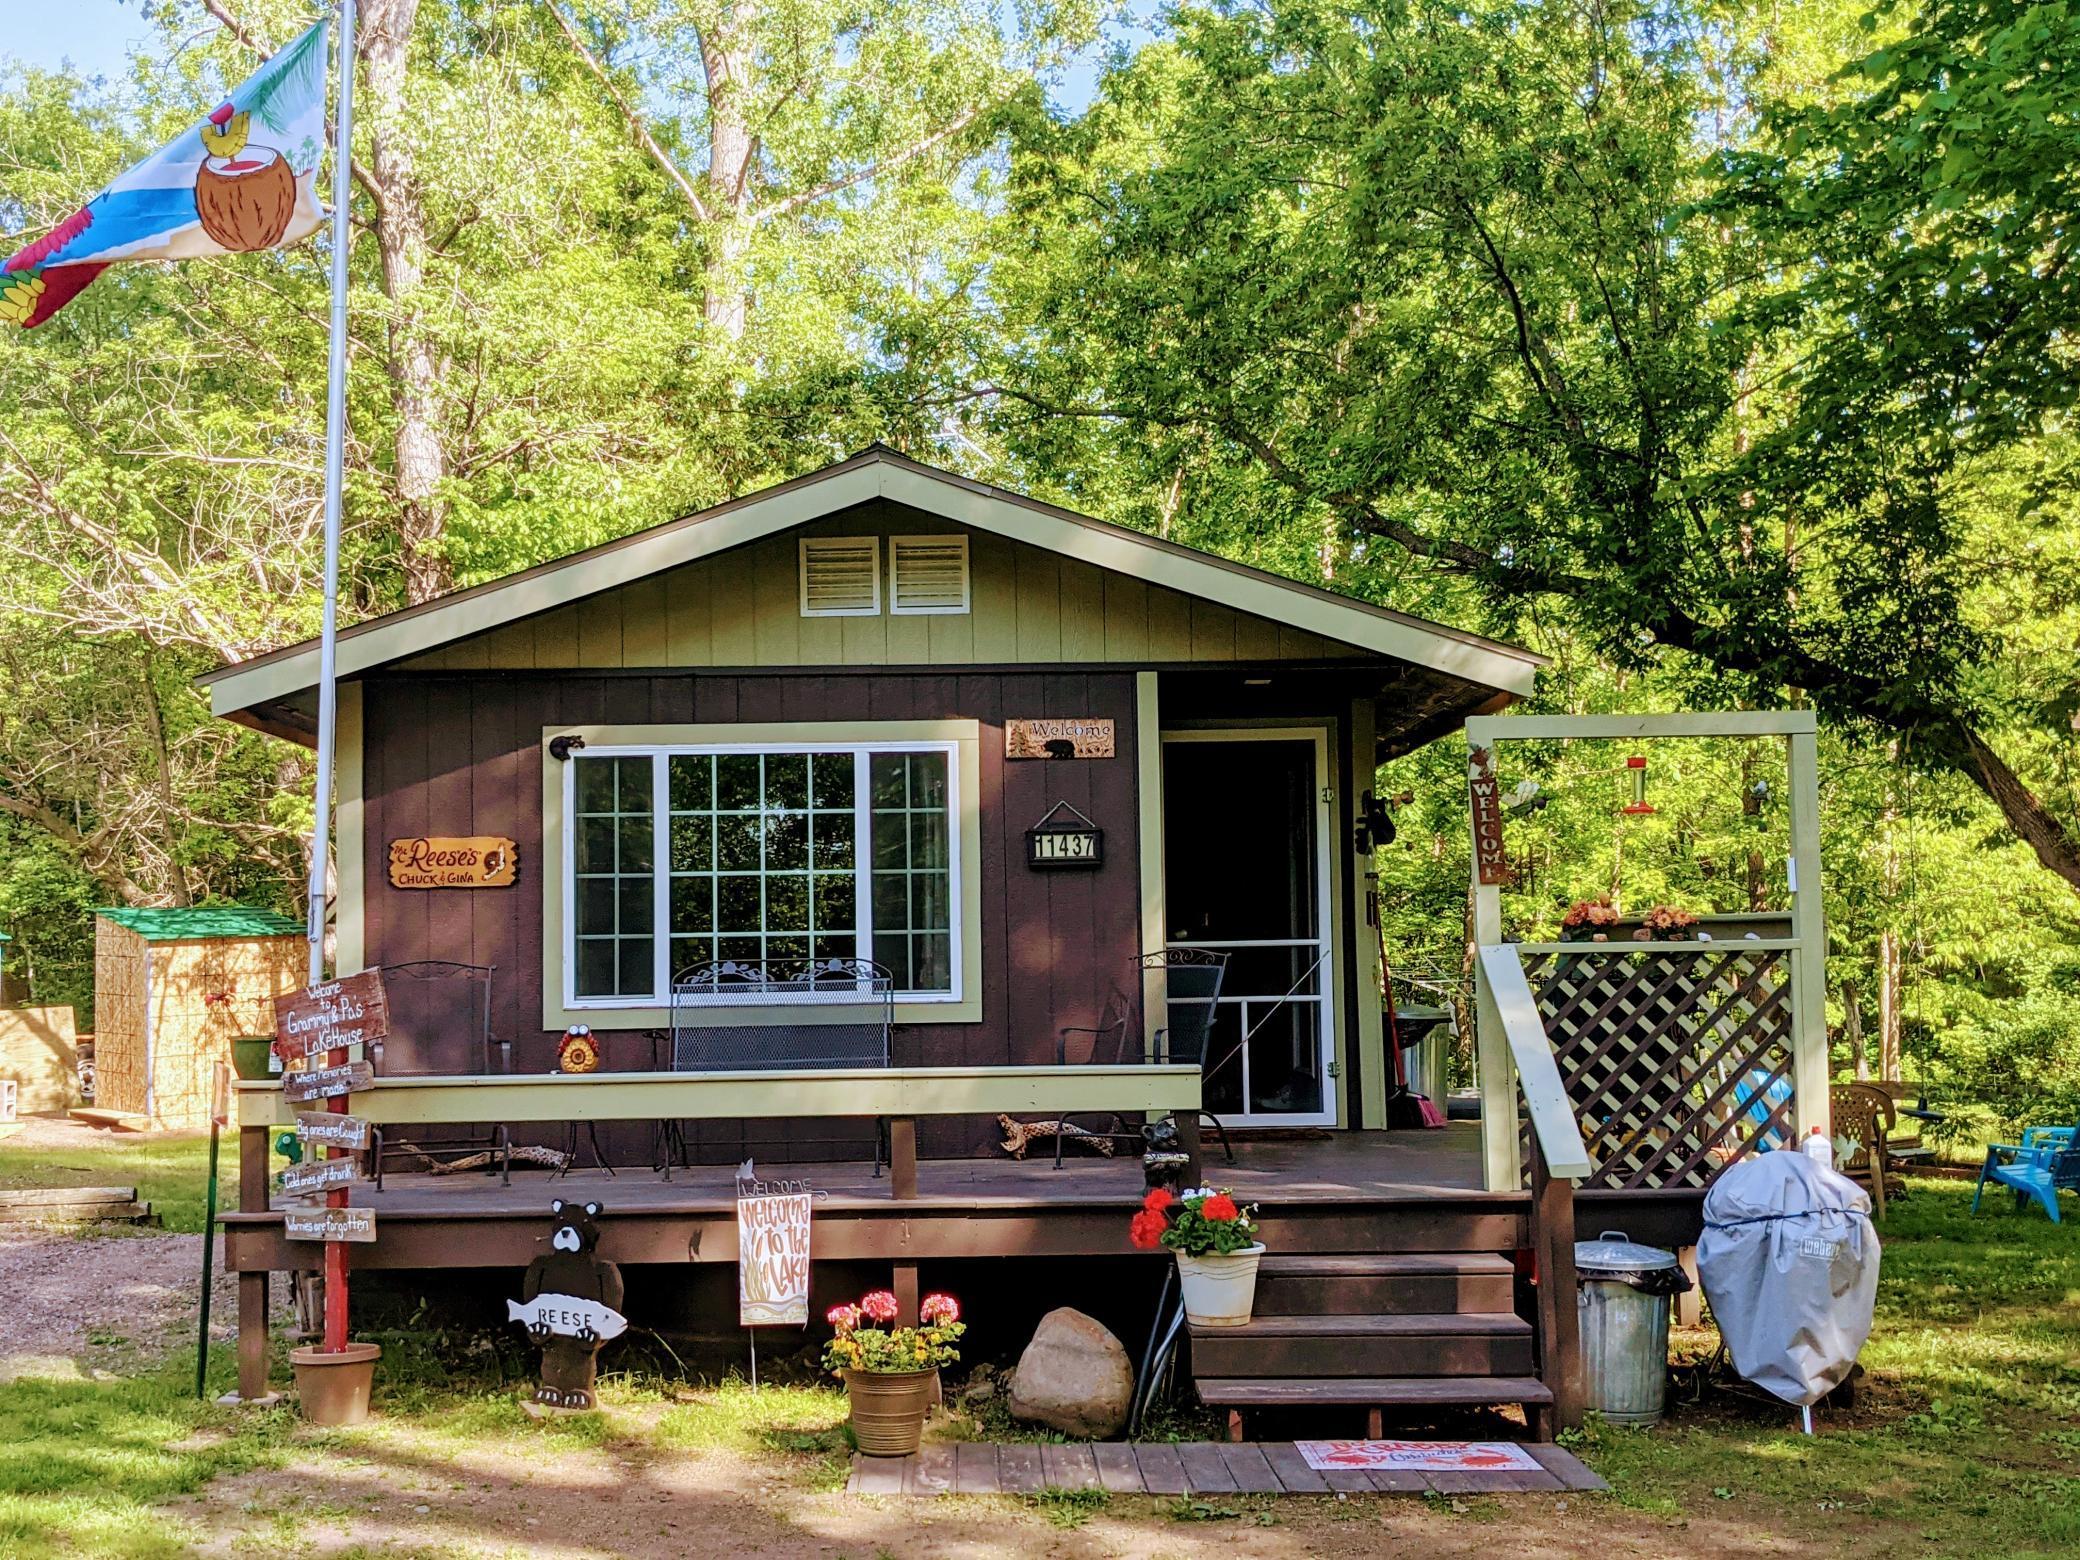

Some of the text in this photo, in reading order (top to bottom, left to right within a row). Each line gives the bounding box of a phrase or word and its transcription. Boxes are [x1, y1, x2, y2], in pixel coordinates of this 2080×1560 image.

[1031, 722, 1111, 737] Welcome
[1036, 835, 1095, 857] 11437
[398, 873, 438, 886] CHUCK
[447, 871, 474, 884] GINA
[306, 982, 343, 1000] Welcome
[287, 994, 363, 1034] Grammy & Pa's
[320, 998, 331, 1010] to
[295, 1072, 317, 1085] Where
[303, 1081, 345, 1101] are made
[296, 1118, 309, 1141] Big
[309, 1125, 325, 1136] ones
[325, 1125, 338, 1137] are
[284, 1171, 301, 1189] Cold
[301, 1174, 316, 1186] ones
[316, 1167, 328, 1188] get
[741, 1178, 813, 1197] WELCOME
[285, 1214, 369, 1239] Worries are forgotten
[765, 1225, 809, 1255] to the
[538, 1308, 593, 1328] REESE
